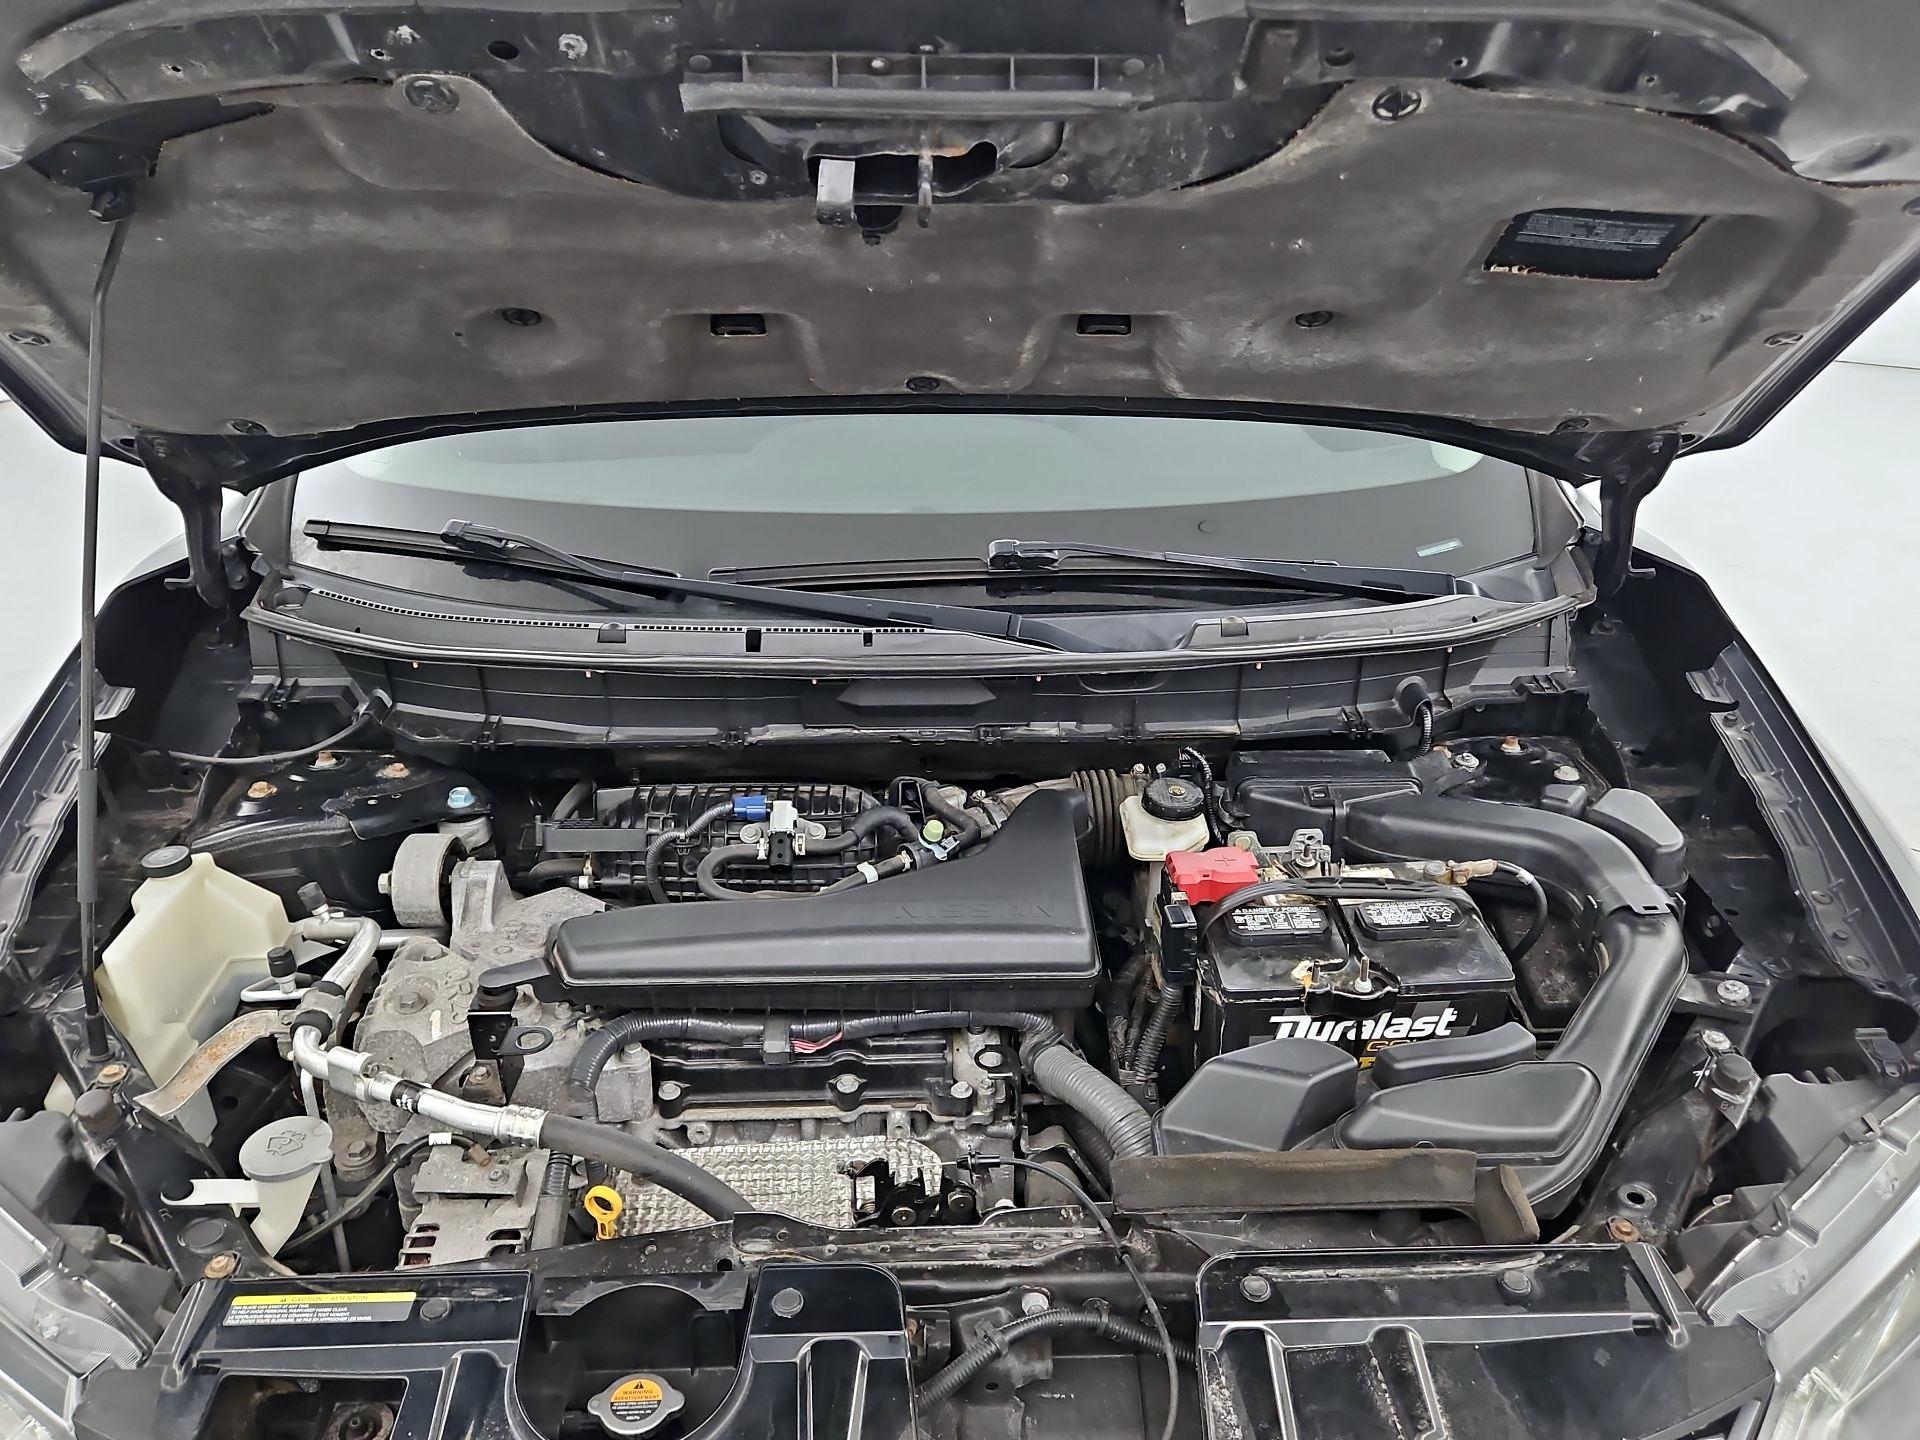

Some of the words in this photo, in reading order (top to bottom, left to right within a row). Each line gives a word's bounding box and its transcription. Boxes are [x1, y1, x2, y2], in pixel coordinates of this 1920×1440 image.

[896, 903, 1061, 919] NISSAN
[1268, 1007, 1458, 1042] Duralast
[330, 1294, 369, 1302] ATTENTION
